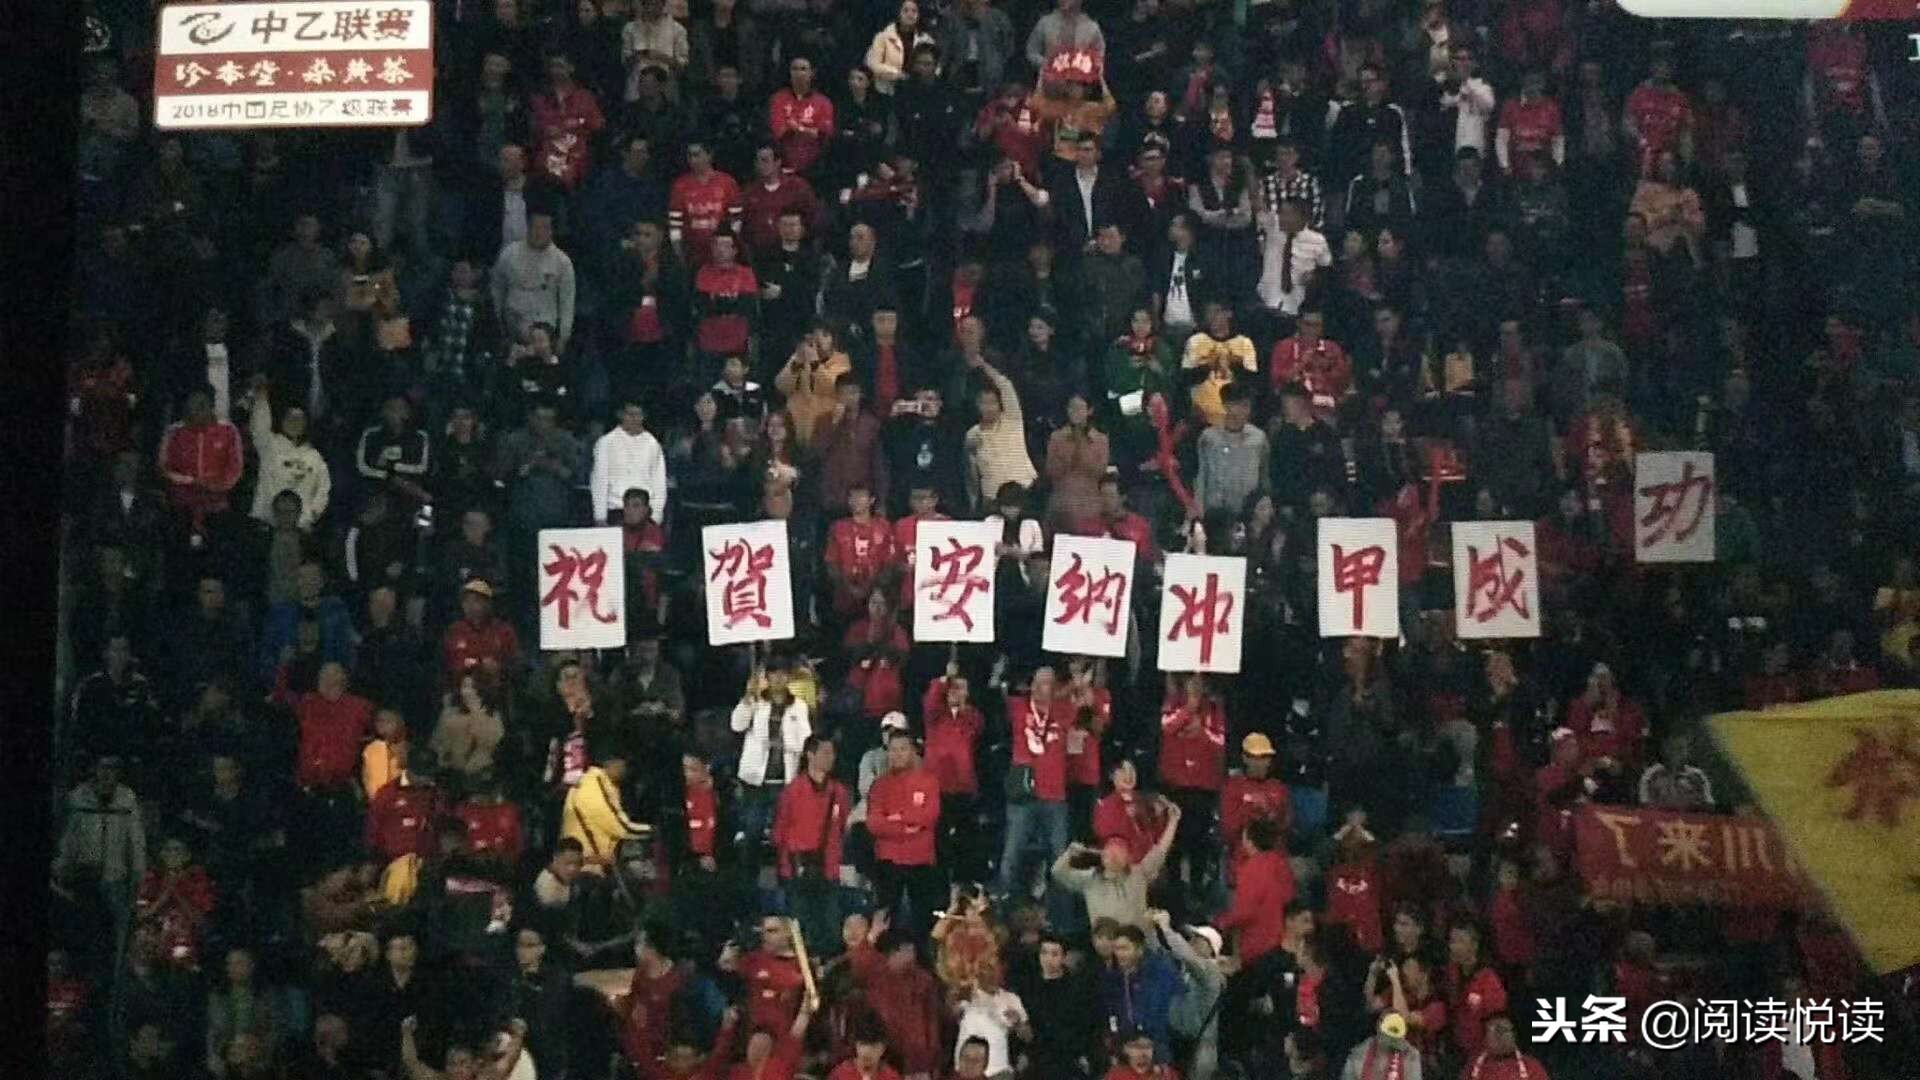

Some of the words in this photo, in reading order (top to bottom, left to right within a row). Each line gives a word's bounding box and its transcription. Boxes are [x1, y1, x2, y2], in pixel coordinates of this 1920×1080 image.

[251, 7, 414, 44] 中乙联赛
[542, 544, 618, 630] 祝
[923, 538, 990, 633] 安
[1053, 552, 1126, 636] 纳
[1167, 573, 1234, 665] 冲
[1330, 543, 1387, 632] 甲
[1466, 535, 1531, 623] 成
[1638, 461, 1712, 548] 功
